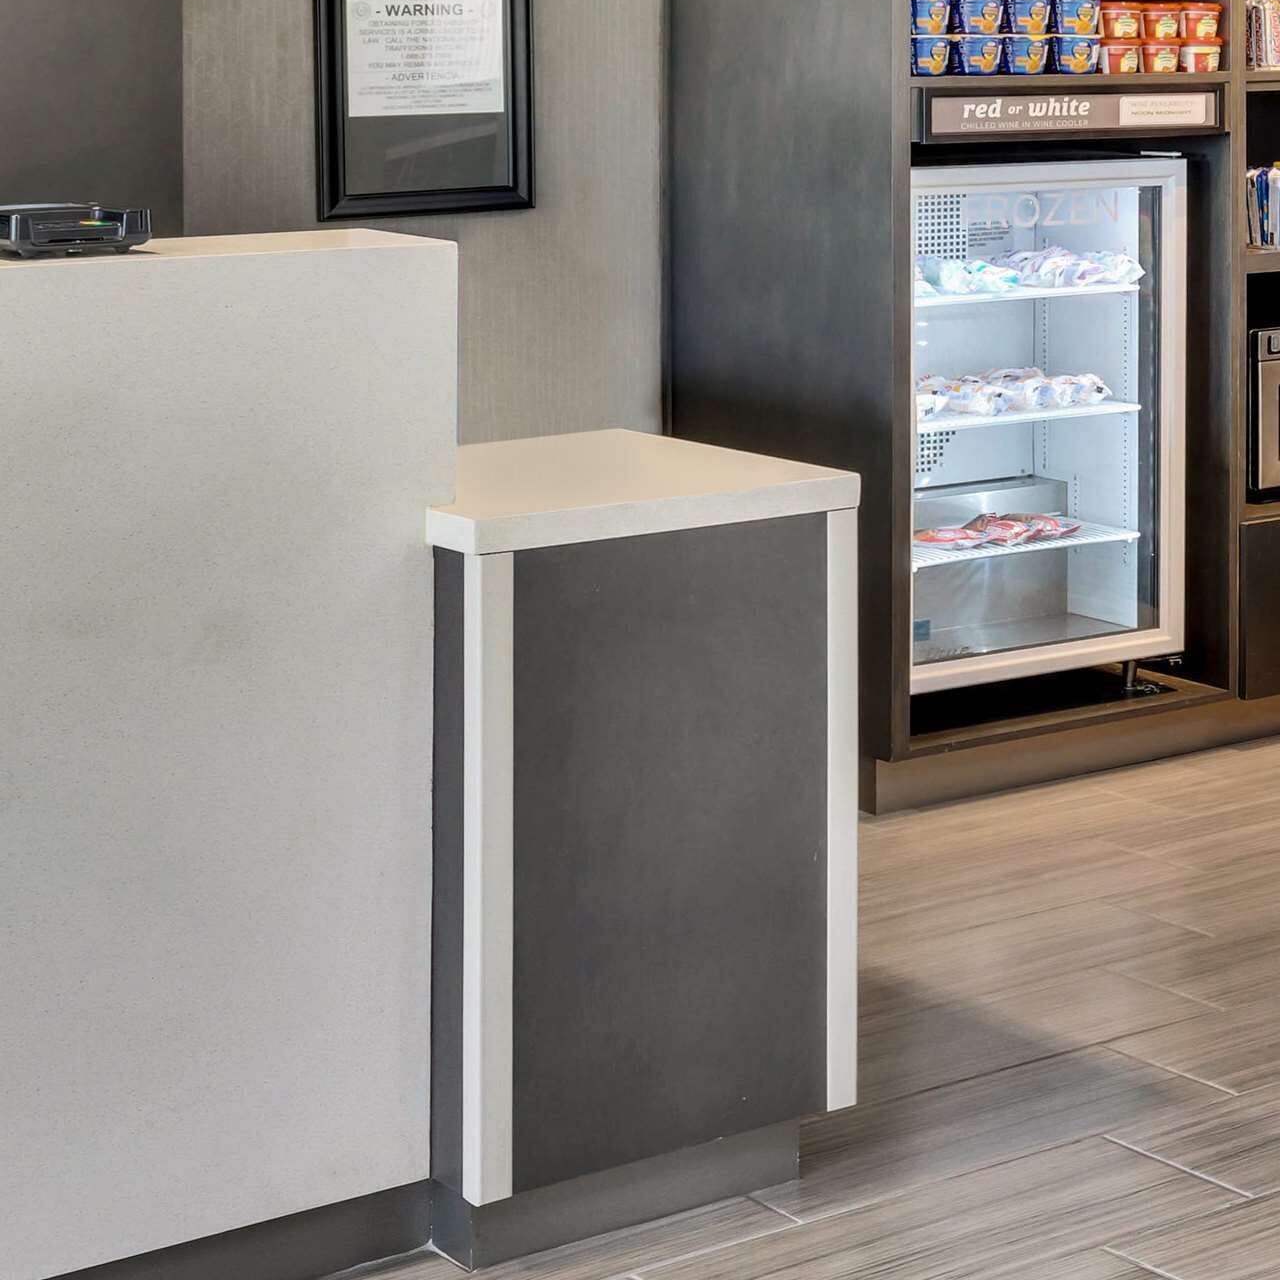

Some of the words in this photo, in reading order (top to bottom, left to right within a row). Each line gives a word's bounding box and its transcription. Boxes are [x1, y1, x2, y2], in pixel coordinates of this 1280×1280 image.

[385, 3, 464, 17] WARNING
[962, 99, 1002, 118] red
[1008, 104, 1023, 115] or
[1028, 96, 1090, 117] white
[960, 121, 996, 130] CHILLED
[998, 120, 1020, 129] WINE
[1056, 118, 1089, 127] COOLER
